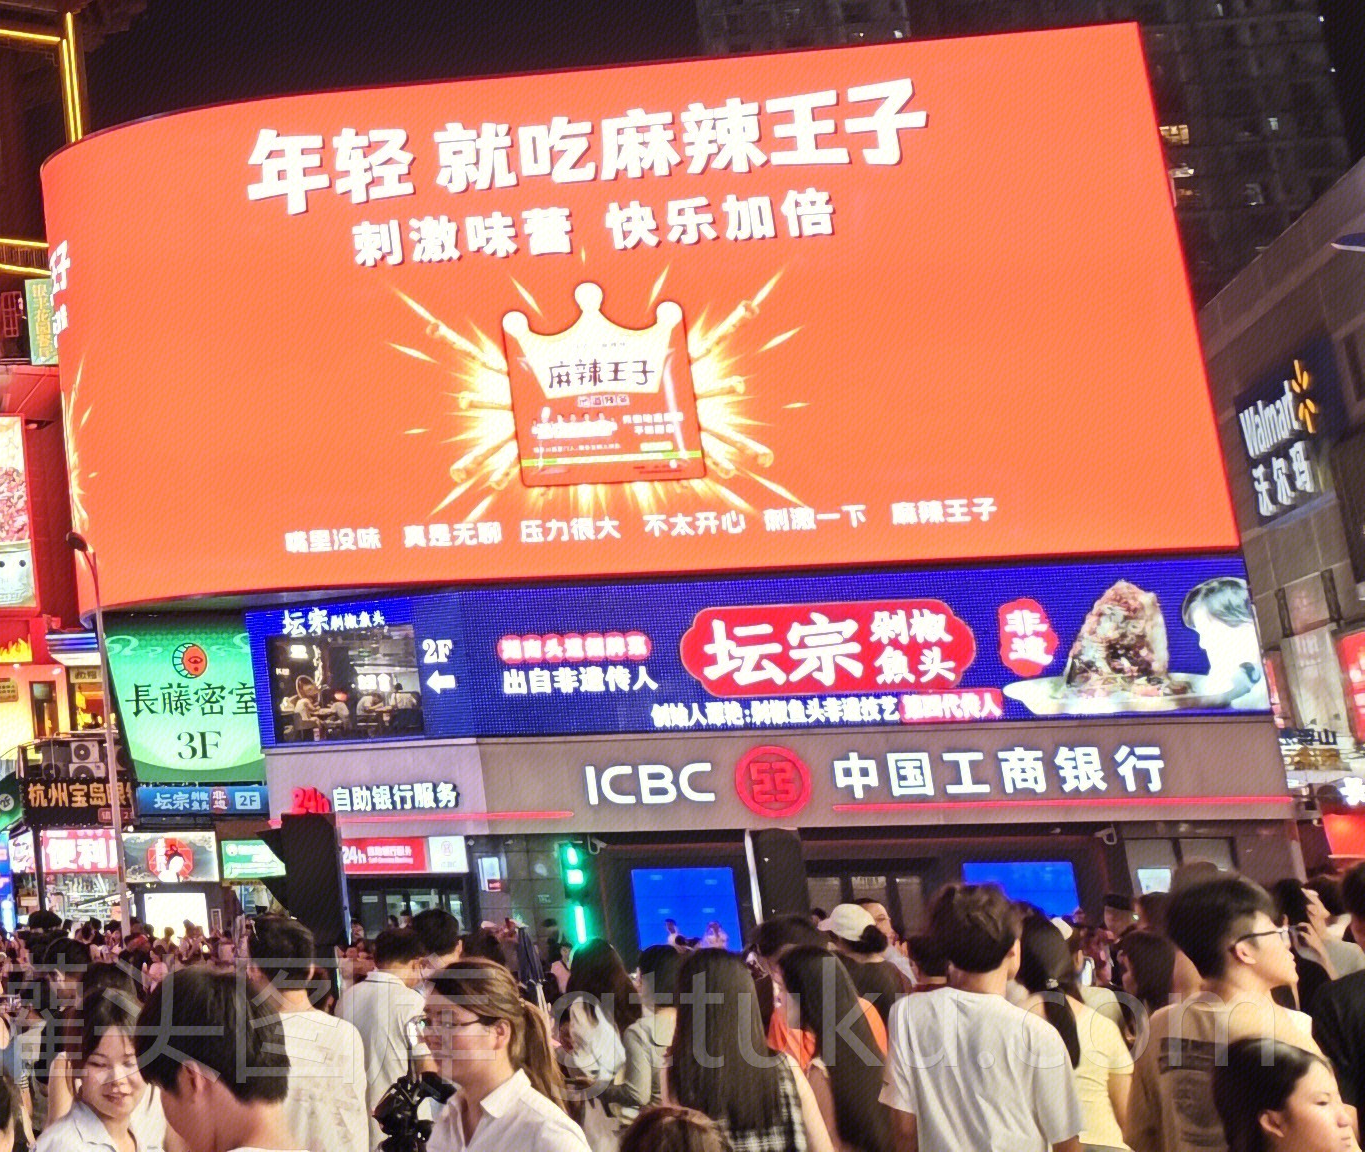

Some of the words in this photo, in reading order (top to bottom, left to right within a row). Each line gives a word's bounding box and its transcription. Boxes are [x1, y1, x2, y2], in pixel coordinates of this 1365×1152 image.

[246, 127, 416, 215] 年轻
[433, 78, 928, 192] 就吃麻辣王子
[352, 207, 573, 268] 刺激味蕾
[605, 188, 835, 249] 快乐加倍
[549, 359, 655, 388] 麻辣王子
[1239, 380, 1302, 459] Walmart
[1252, 441, 1315, 516] 沃尔玛
[284, 526, 382, 554] 嘴里没味
[403, 521, 503, 550] 真是无聊
[520, 515, 621, 545] 压力很大
[644, 508, 746, 538] 不太开心
[763, 502, 867, 532] 刺激一下
[891, 497, 998, 526] 麻辣王子
[422, 638, 453, 664] 2F
[703, 611, 865, 686] 坛宗
[502, 665, 659, 695] 出自非遗传人
[125, 682, 258, 718] 長藤密室
[177, 730, 222, 760] 3F
[584, 762, 716, 806] ICBC
[832, 745, 1166, 800] 中国工商银行
[29, 781, 133, 809] 杭州宝岛眼
[153, 791, 190, 811] 坛宗
[239, 794, 259, 807] 2F
[331, 782, 459, 813] 自助银行服务
